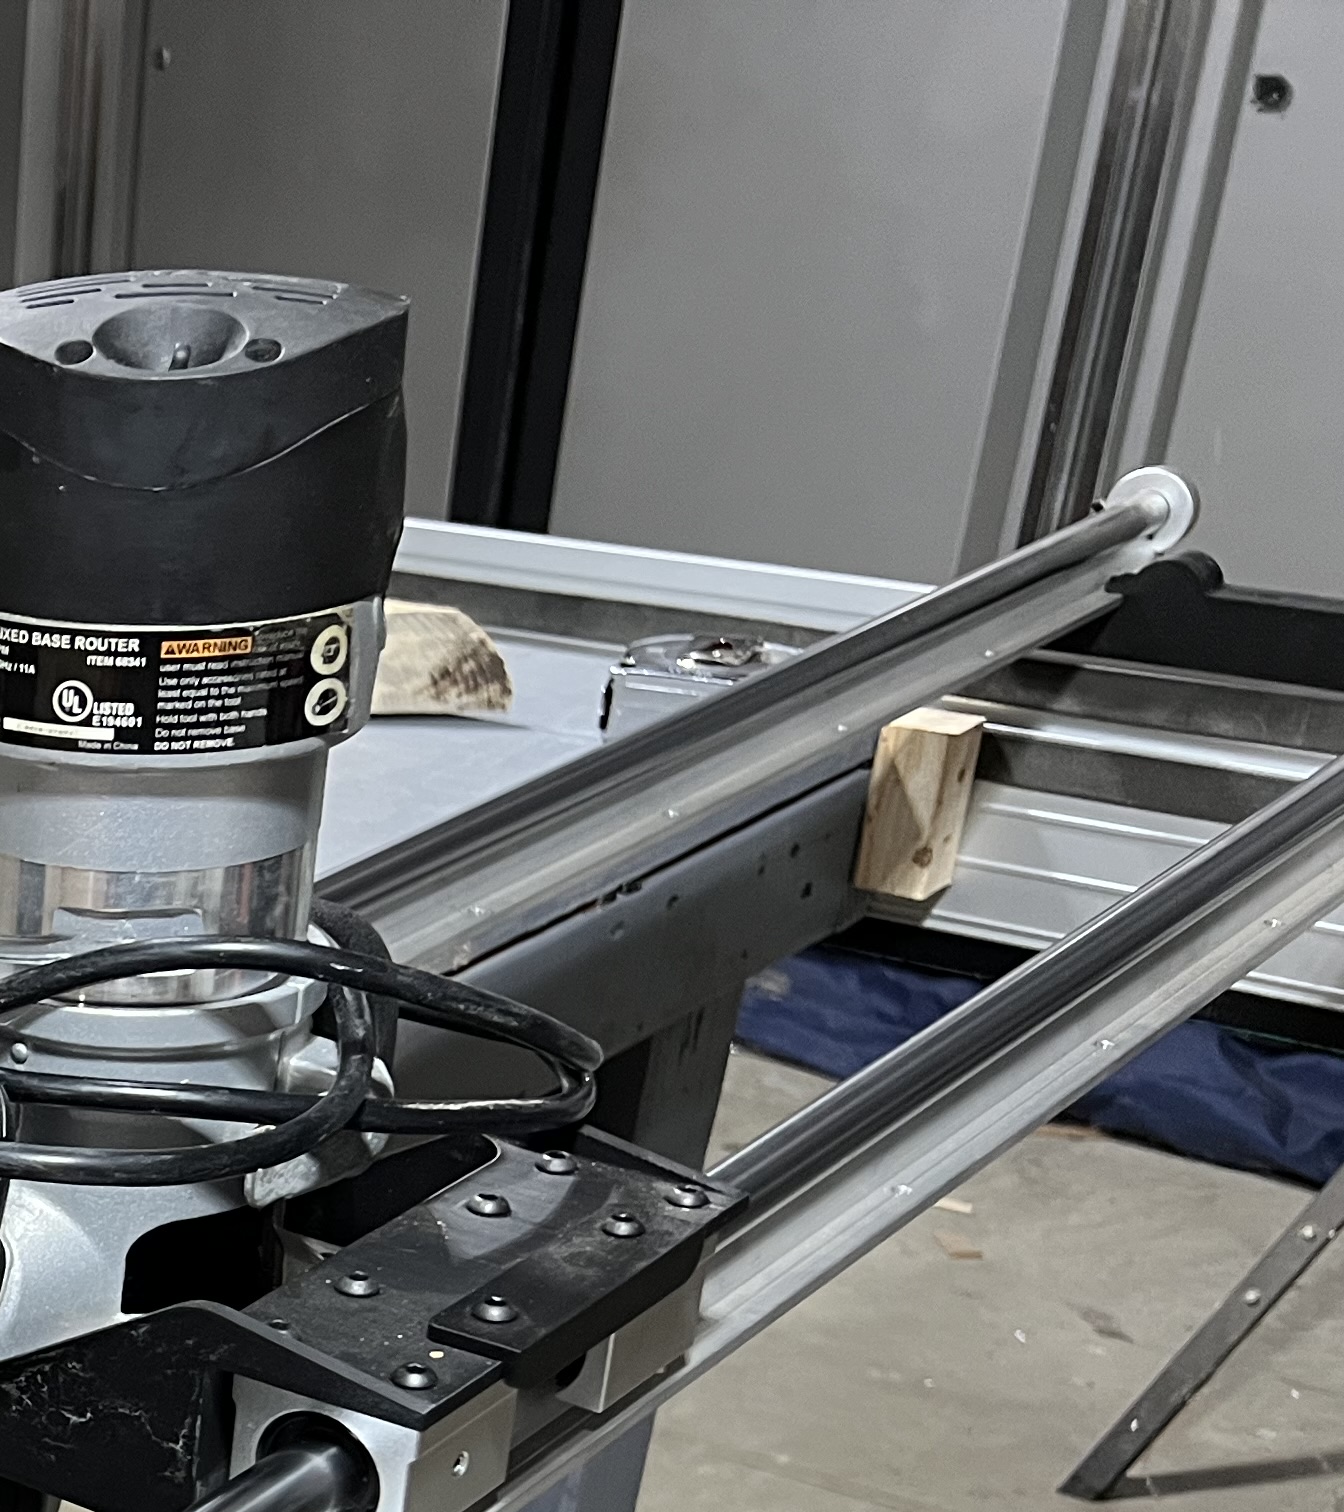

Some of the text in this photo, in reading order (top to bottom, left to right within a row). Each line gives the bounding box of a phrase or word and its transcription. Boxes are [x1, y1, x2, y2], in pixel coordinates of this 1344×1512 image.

[31, 631, 71, 649] BASE
[74, 635, 140, 653] ROUTER
[174, 639, 250, 656] WARNING
[86, 655, 114, 667] ITEM
[19, 663, 36, 675] 11A
[158, 677, 179, 686] Use
[179, 676, 200, 687] only
[209, 687, 220, 696] to
[221, 686, 236, 695] the
[61, 688, 83, 714] UL
[157, 699, 193, 710] marked
[194, 700, 206, 709] on
[207, 698, 223, 708] the
[92, 701, 135, 716] LISTED
[156, 714, 179, 724] Hold
[179, 713, 198, 723] tool
[199, 713, 218, 722] with
[219, 710, 240, 721] both
[154, 728, 170, 738] Do
[170, 728, 187, 737] not
[187, 727, 222, 737] remove
[78, 740, 139, 750] Made in China
[153, 741, 170, 751] DO
[170, 739, 192, 750] NOT
